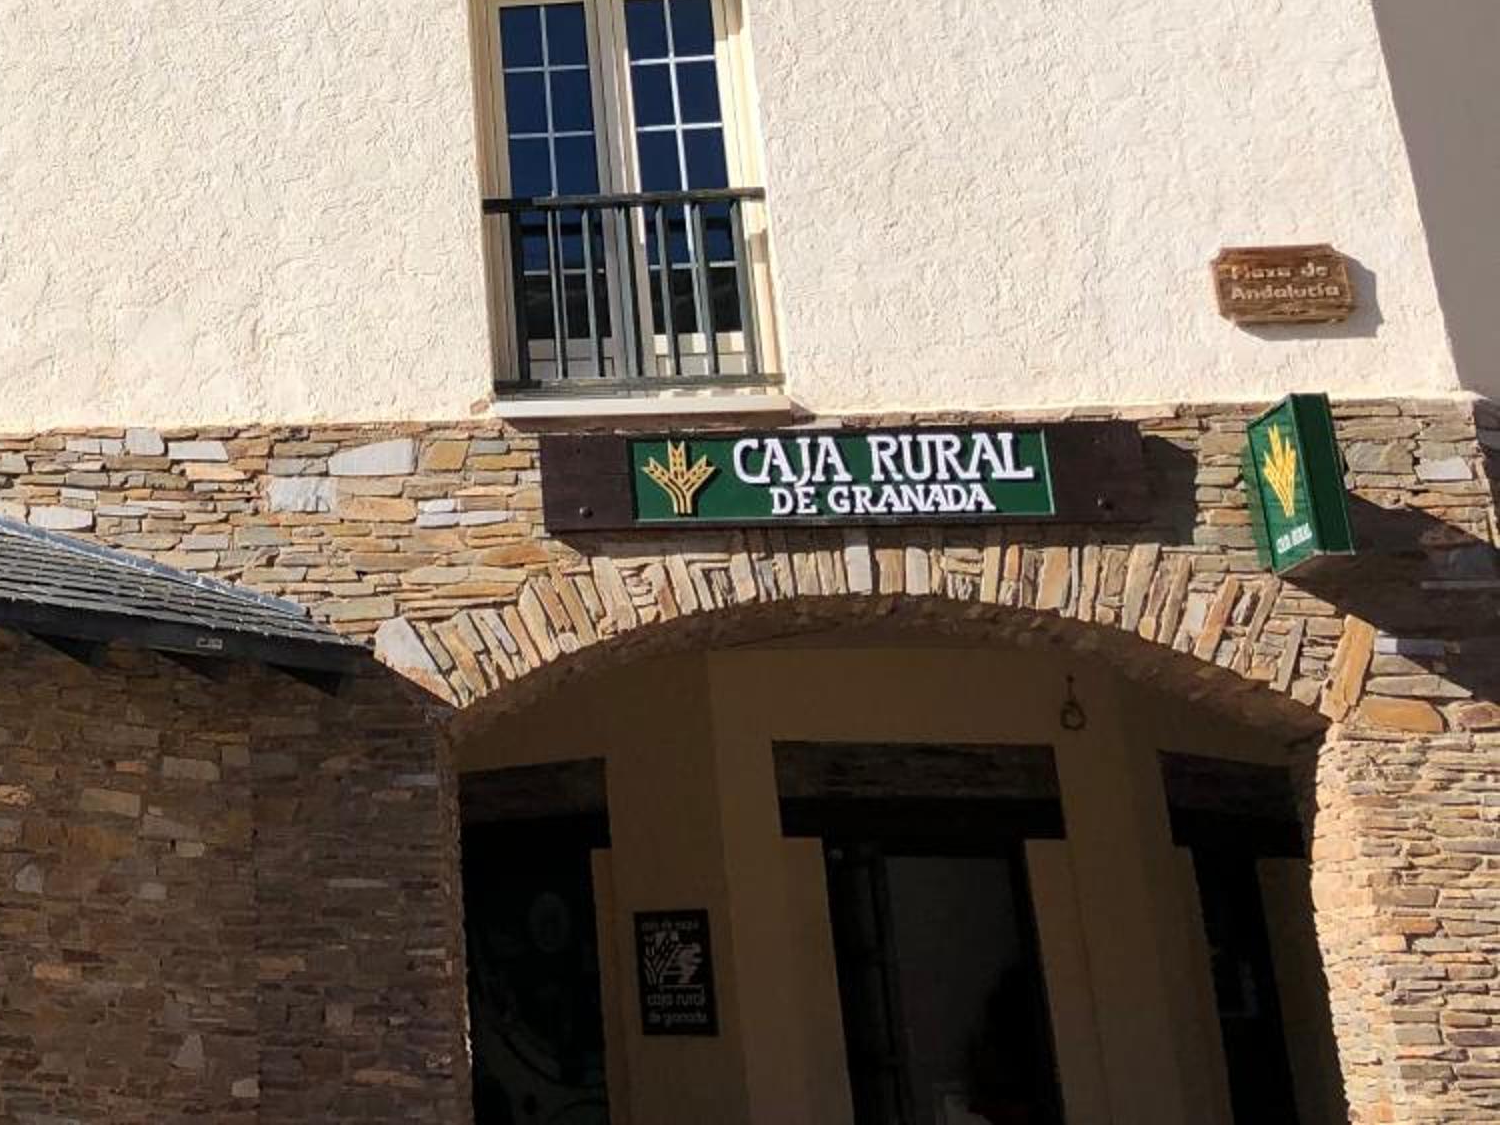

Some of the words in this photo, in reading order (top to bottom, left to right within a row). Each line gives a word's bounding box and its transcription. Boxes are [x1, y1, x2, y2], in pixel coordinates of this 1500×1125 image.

[1300, 262, 1329, 278] de
[733, 436, 852, 486] CAJA
[867, 432, 1035, 482] RURAL
[769, 486, 818, 515] DE
[826, 482, 997, 515] GRANADA
